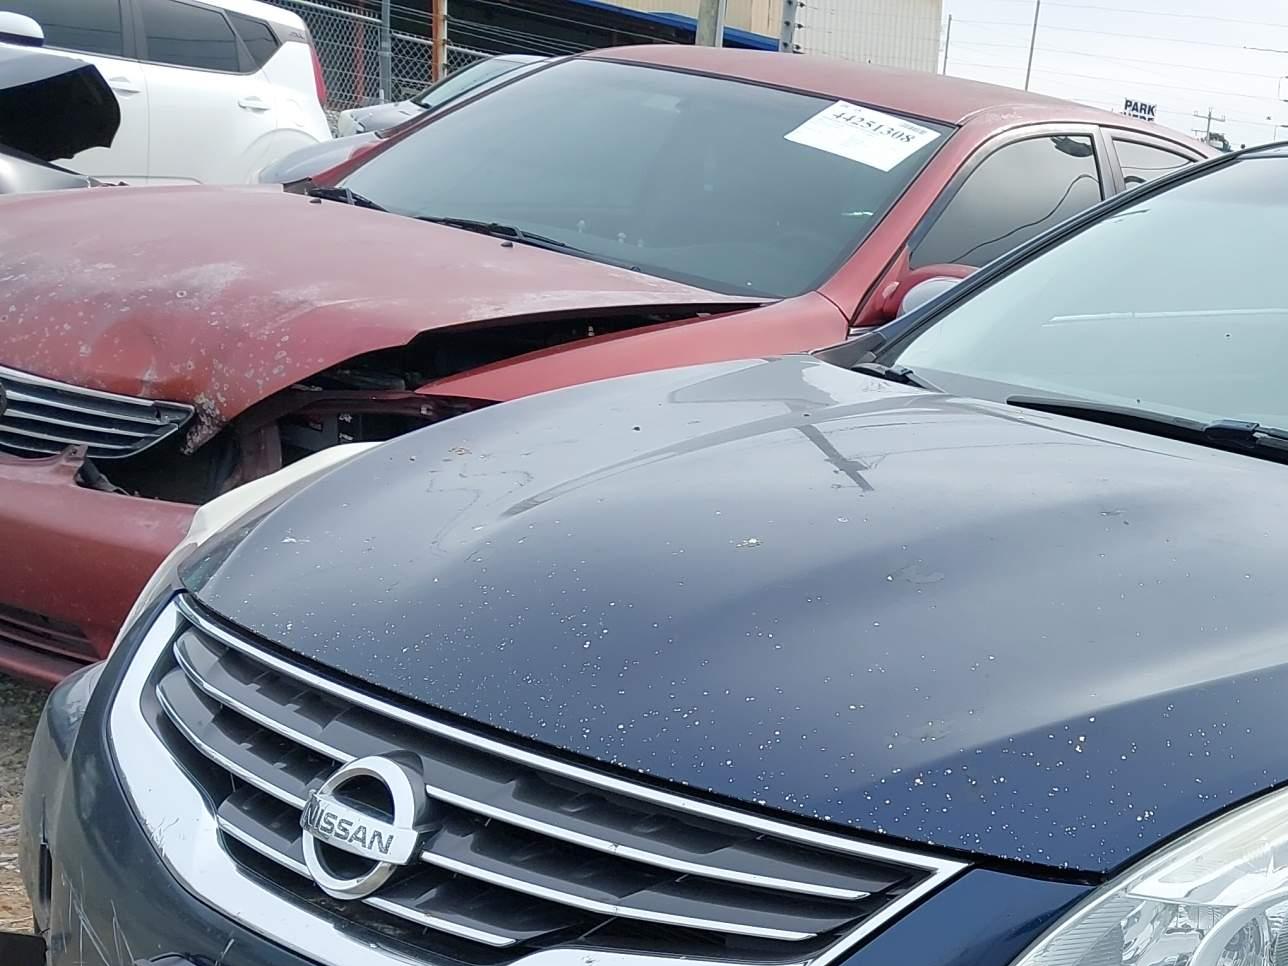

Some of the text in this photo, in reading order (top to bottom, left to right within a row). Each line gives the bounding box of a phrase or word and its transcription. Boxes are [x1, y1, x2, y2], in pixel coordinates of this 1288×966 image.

[1124, 99, 1156, 117] PARK
[832, 111, 916, 143] 44251308
[301, 797, 394, 855] NISSAN
